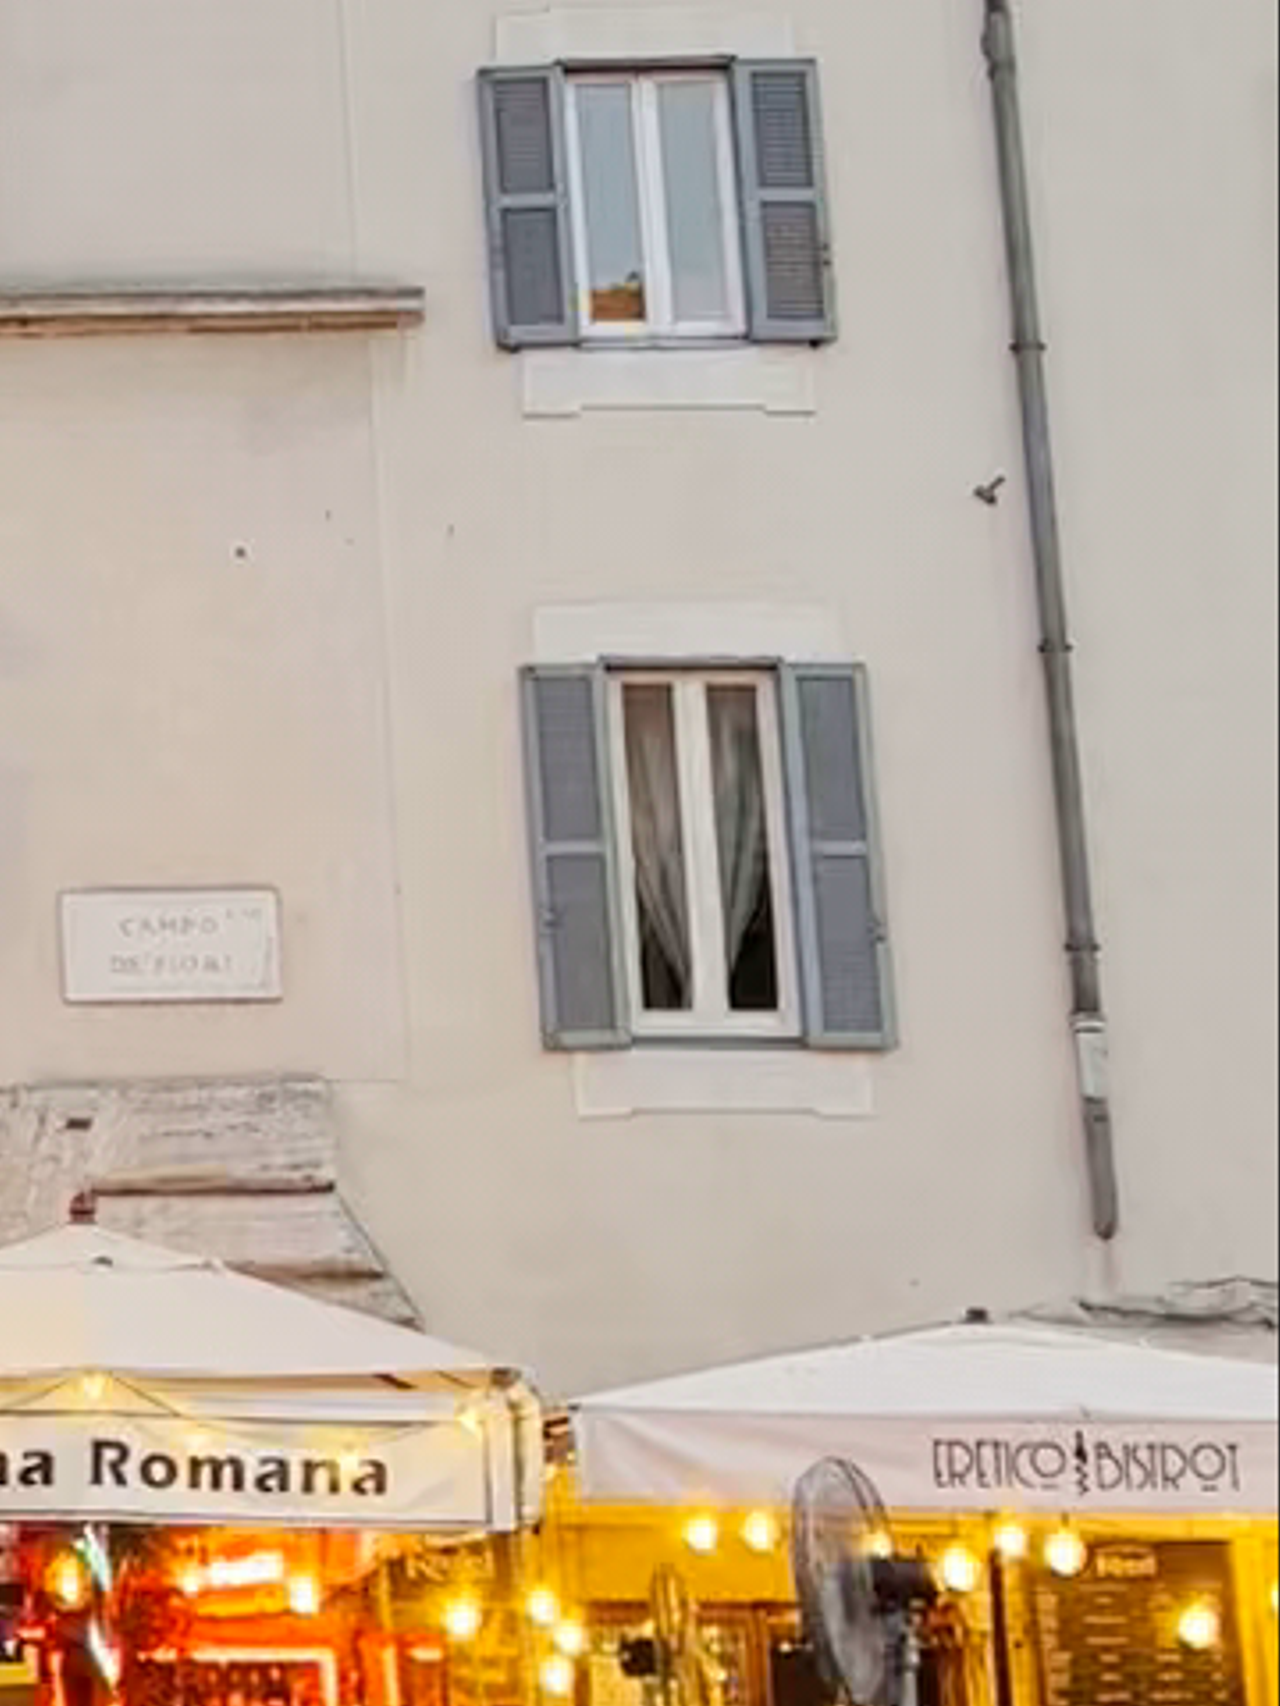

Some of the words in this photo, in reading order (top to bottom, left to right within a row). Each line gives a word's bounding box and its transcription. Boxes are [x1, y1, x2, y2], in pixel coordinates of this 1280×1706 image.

[90, 1439, 389, 1496] Romana
[933, 1439, 1067, 1491] ERETICO
[1094, 1440, 1241, 1492] BISTROT
